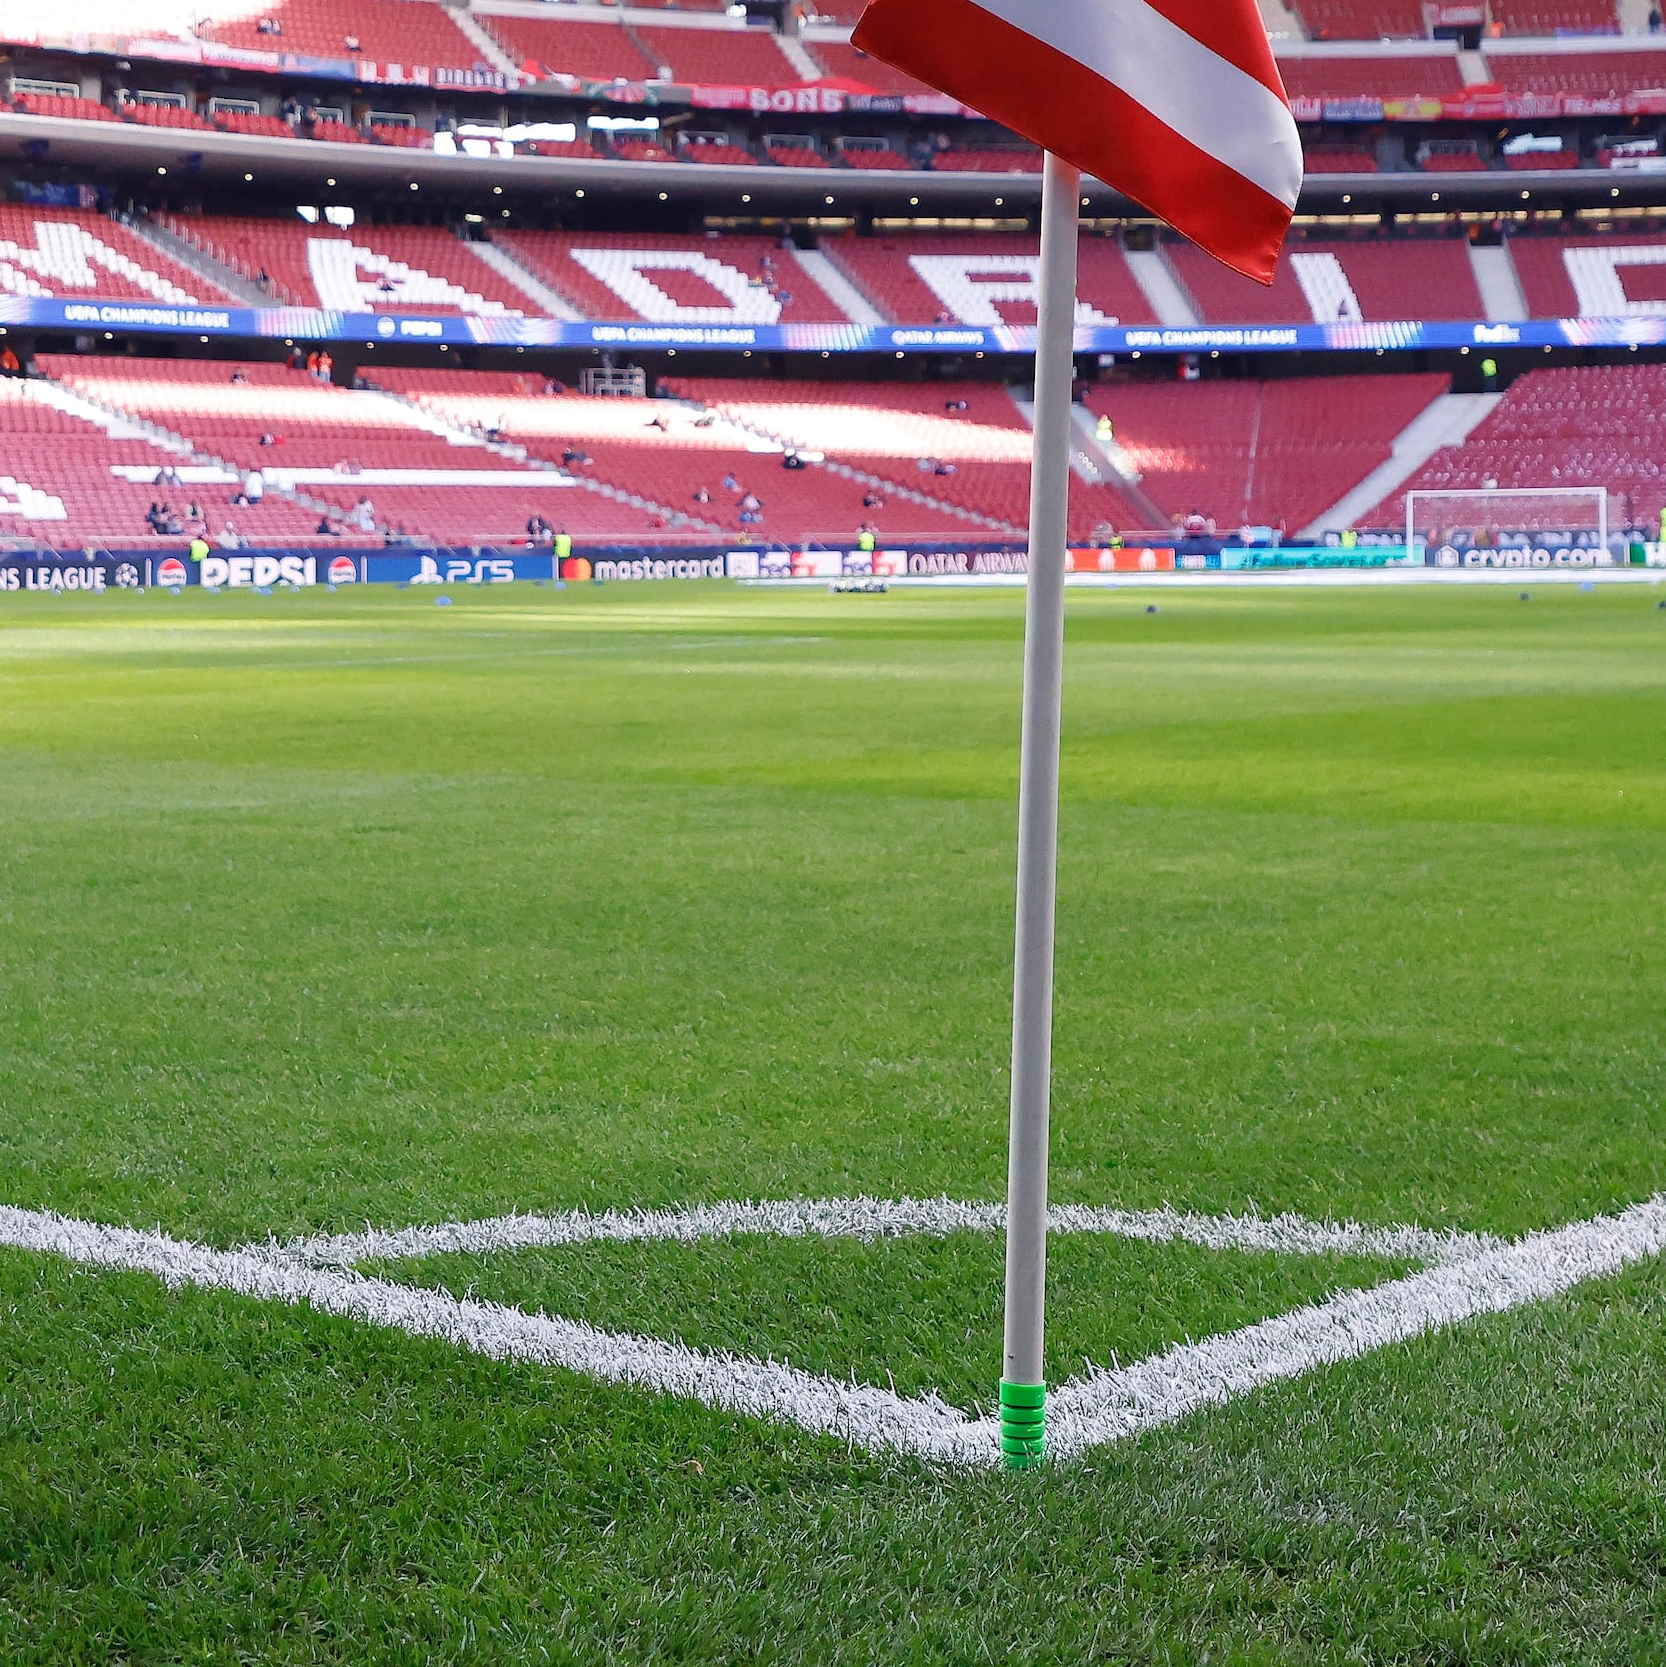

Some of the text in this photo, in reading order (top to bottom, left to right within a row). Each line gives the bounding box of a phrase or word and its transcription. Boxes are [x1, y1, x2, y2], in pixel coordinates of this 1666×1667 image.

[25, 566, 107, 590] LEAGUE
[199, 556, 317, 587] PEPSI
[446, 559, 516, 584] PS5
[594, 554, 725, 580] mastercard
